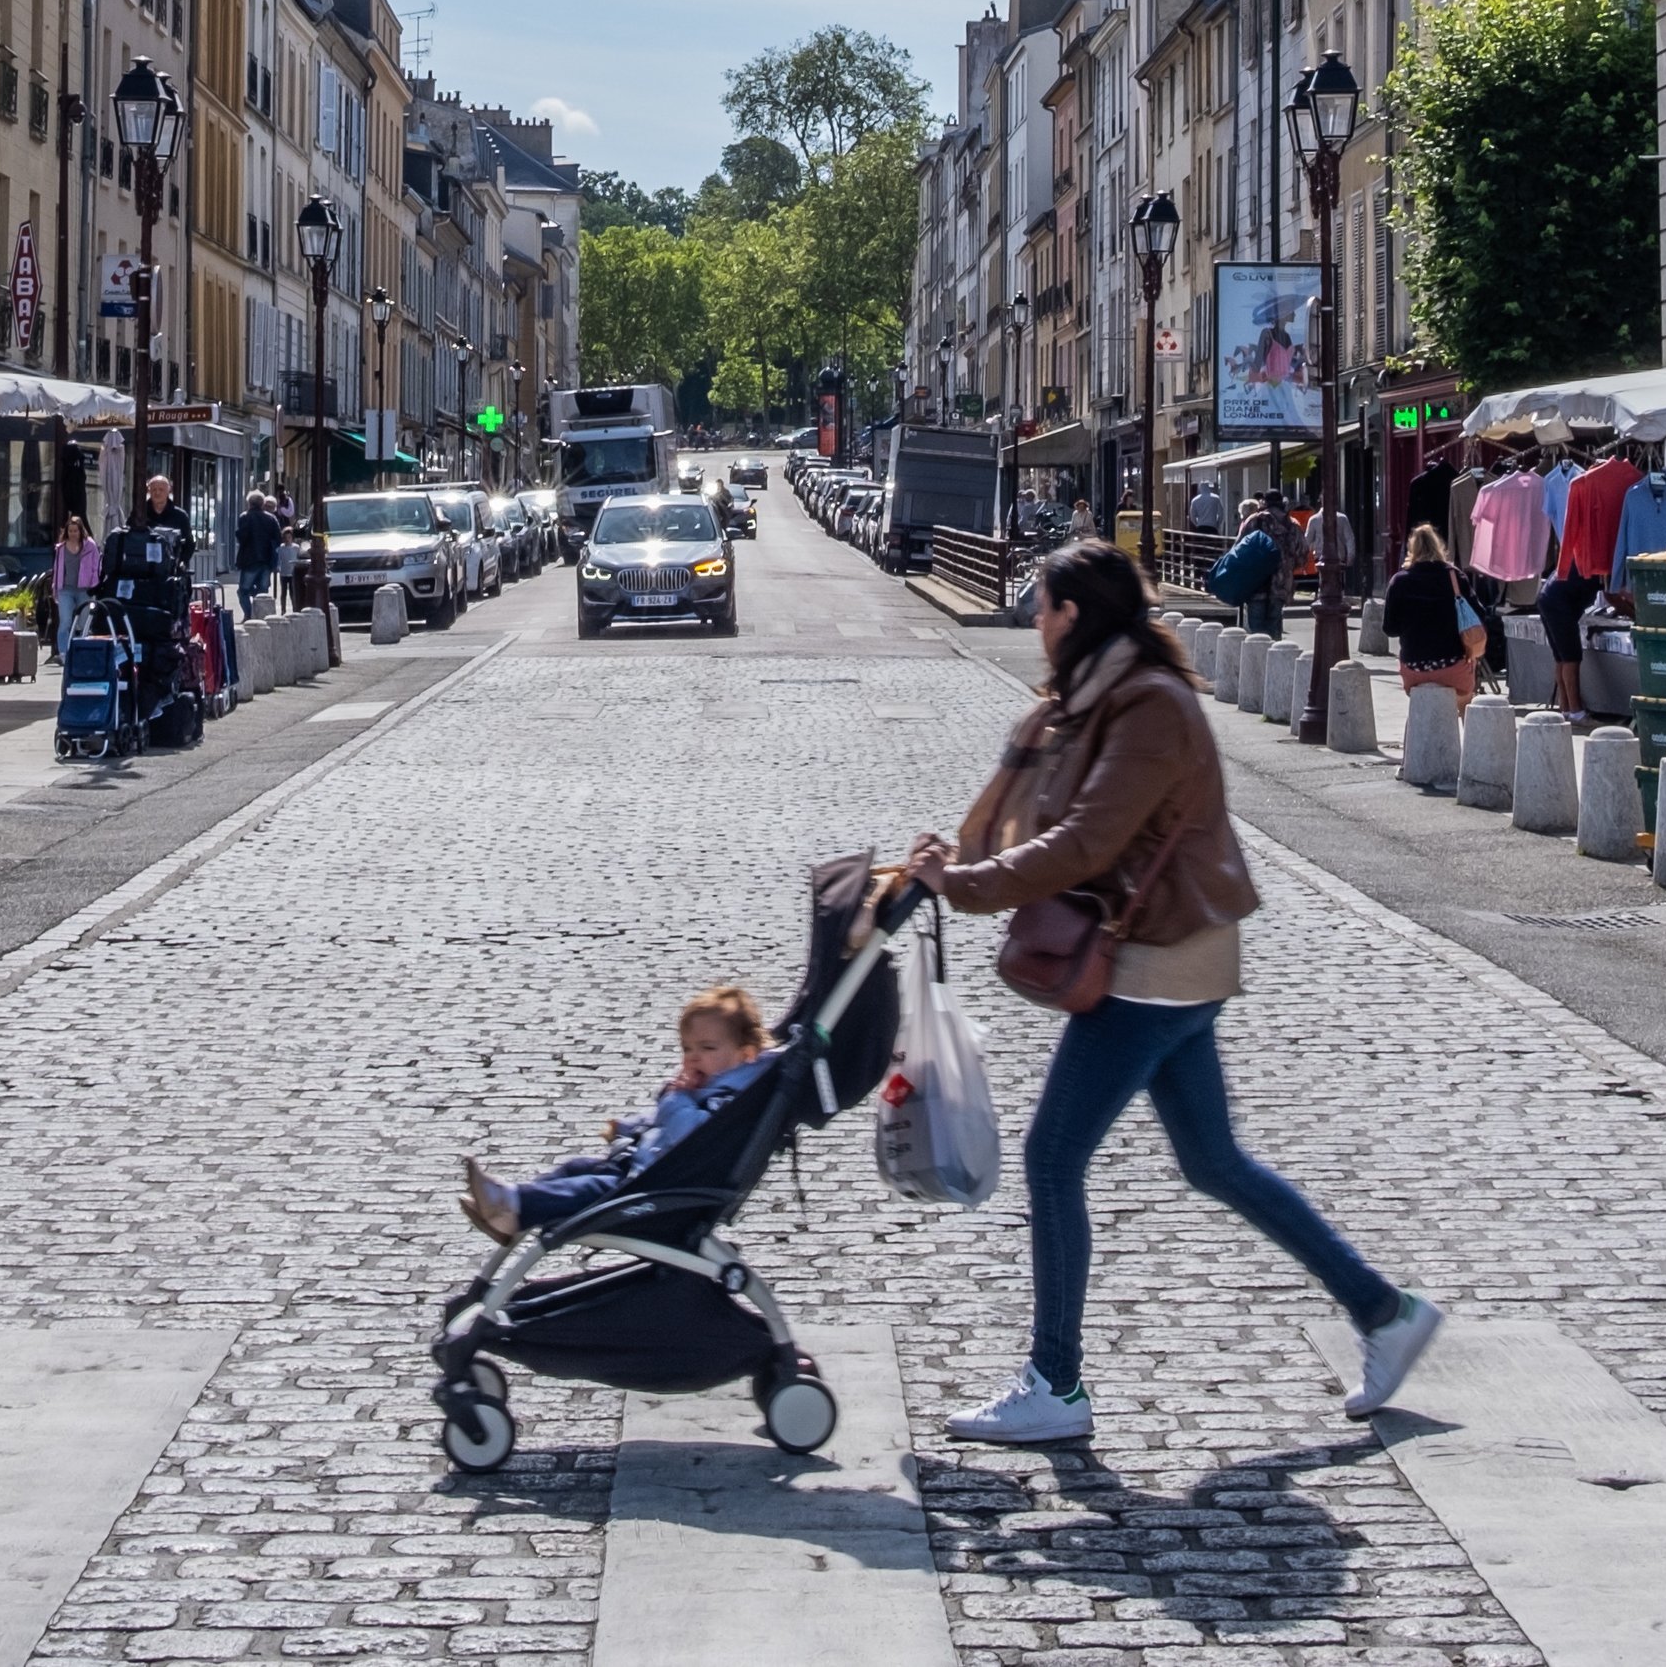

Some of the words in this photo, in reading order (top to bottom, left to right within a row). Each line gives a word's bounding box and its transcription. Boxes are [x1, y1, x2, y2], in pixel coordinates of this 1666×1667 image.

[16, 235, 34, 338] TABAC
[1223, 405, 1261, 413] DIANE
[158, 410, 189, 423] Rouge
